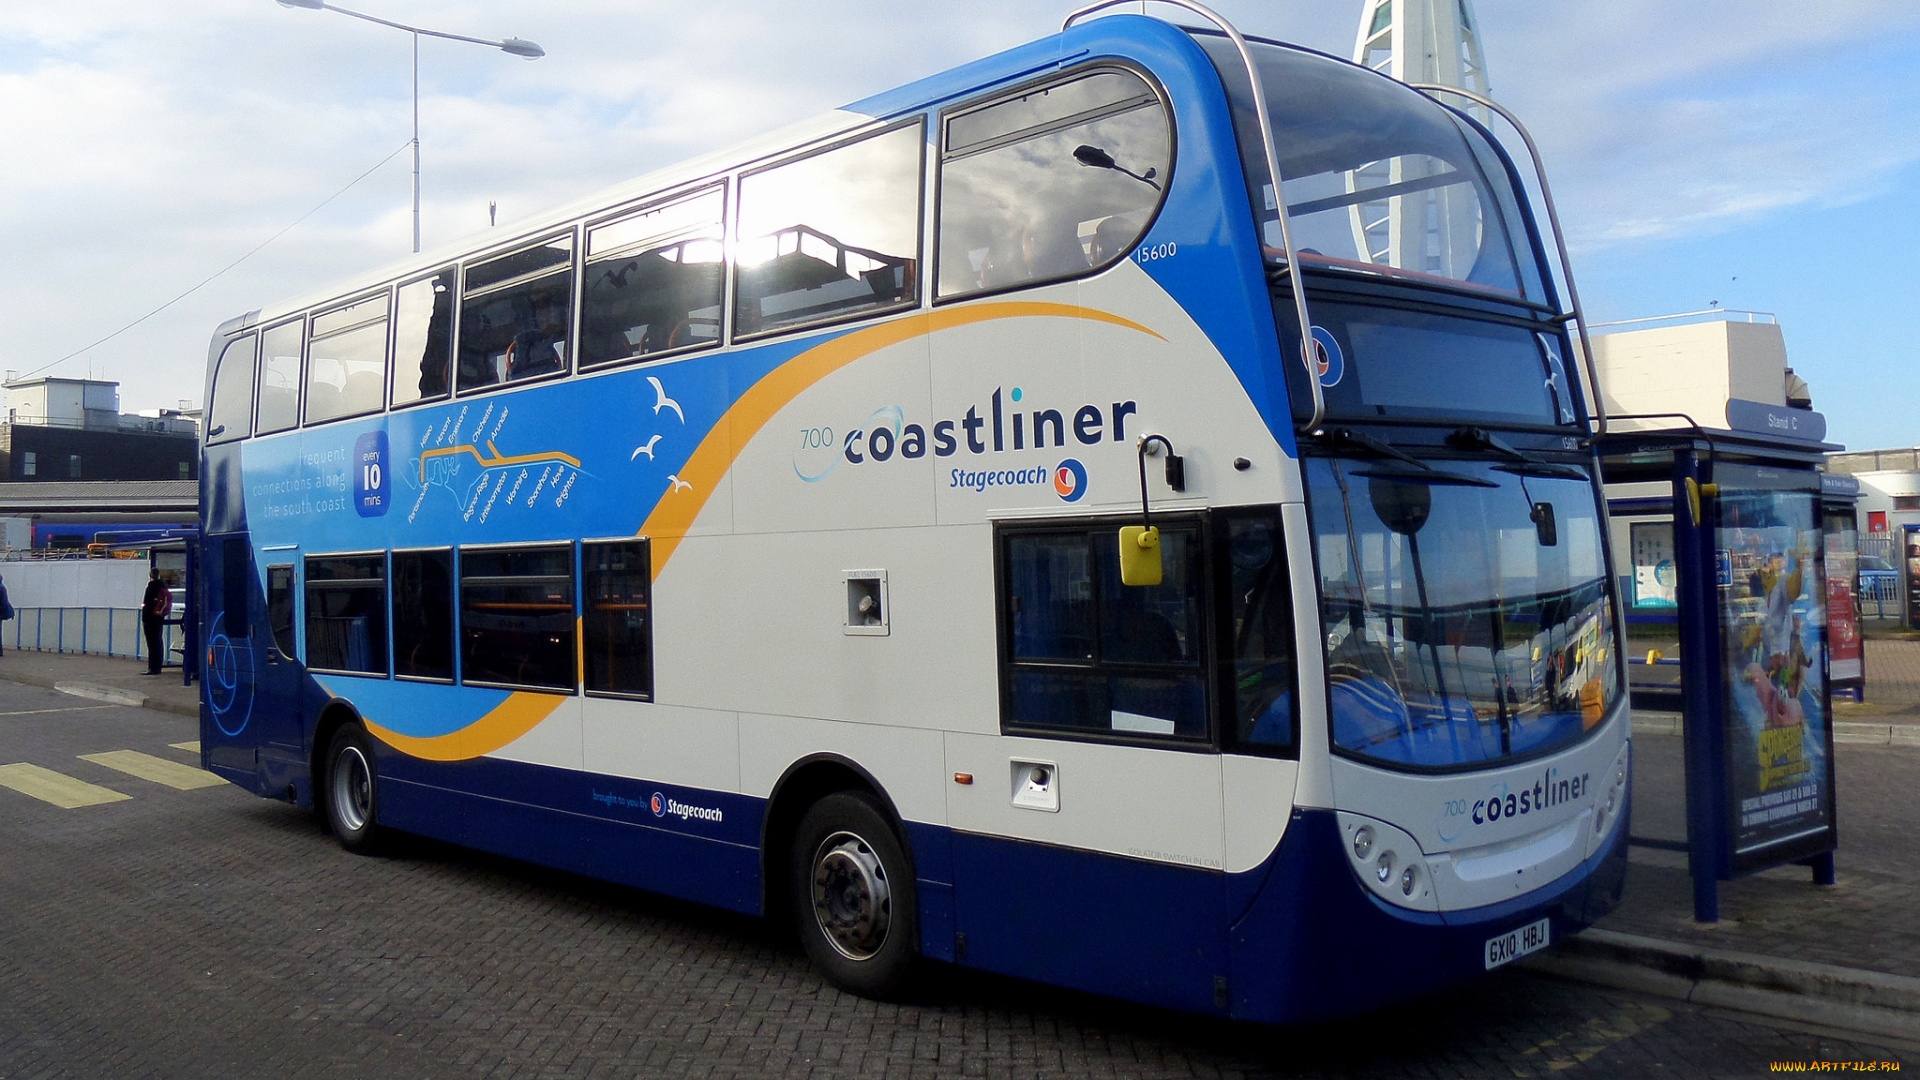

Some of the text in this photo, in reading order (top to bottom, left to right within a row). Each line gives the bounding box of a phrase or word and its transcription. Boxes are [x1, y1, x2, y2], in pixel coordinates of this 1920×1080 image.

[1137, 241, 1177, 264] 15600
[491, 406, 509, 442] Arundel
[800, 385, 1137, 464] 700 coastliner
[1768, 413, 1798, 431] Stand C
[299, 446, 345, 469] frequent
[363, 451, 380, 462] every
[252, 467, 346, 497] connections along
[363, 463, 382, 491] 10
[506, 468, 529, 506] Worthing
[527, 466, 552, 509] Shoreham
[550, 465, 566, 489] Hove
[555, 471, 578, 508] Brighton
[949, 465, 1047, 492] Stagecoach
[264, 495, 346, 518] the south coast
[364, 493, 382, 506] mins
[592, 788, 723, 822] brought to you by Stagecoach
[1444, 767, 1589, 825] 700 coastliner
[1490, 922, 1545, 963] GX10 HBJ
